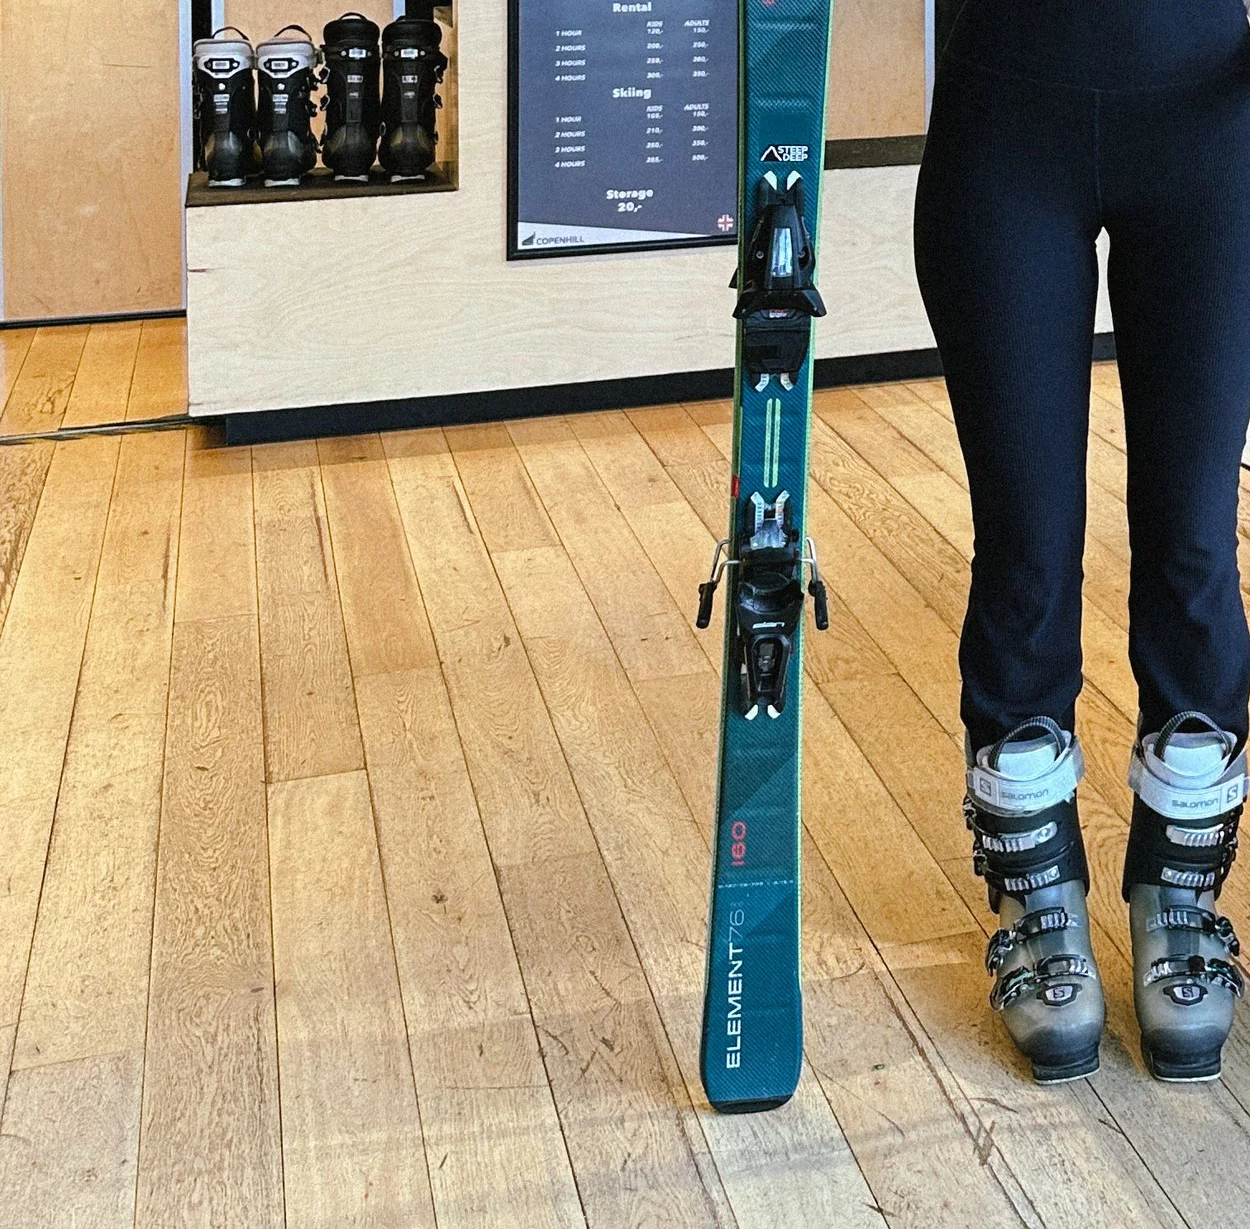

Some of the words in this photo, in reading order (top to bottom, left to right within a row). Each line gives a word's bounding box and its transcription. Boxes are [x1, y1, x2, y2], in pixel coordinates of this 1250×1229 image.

[612, 2, 652, 13] Rental
[612, 87, 652, 99] Skiing
[684, 103, 710, 111] ADULTS
[561, 115, 582, 123] HOUR
[777, 146, 809, 154] STEEP
[783, 153, 809, 161] DEEP
[561, 160, 586, 168] HOURS
[606, 189, 653, 200] Storage
[617, 202, 642, 212] 20,-
[536, 236, 584, 246] COPENHILL
[731, 821, 746, 867] 160
